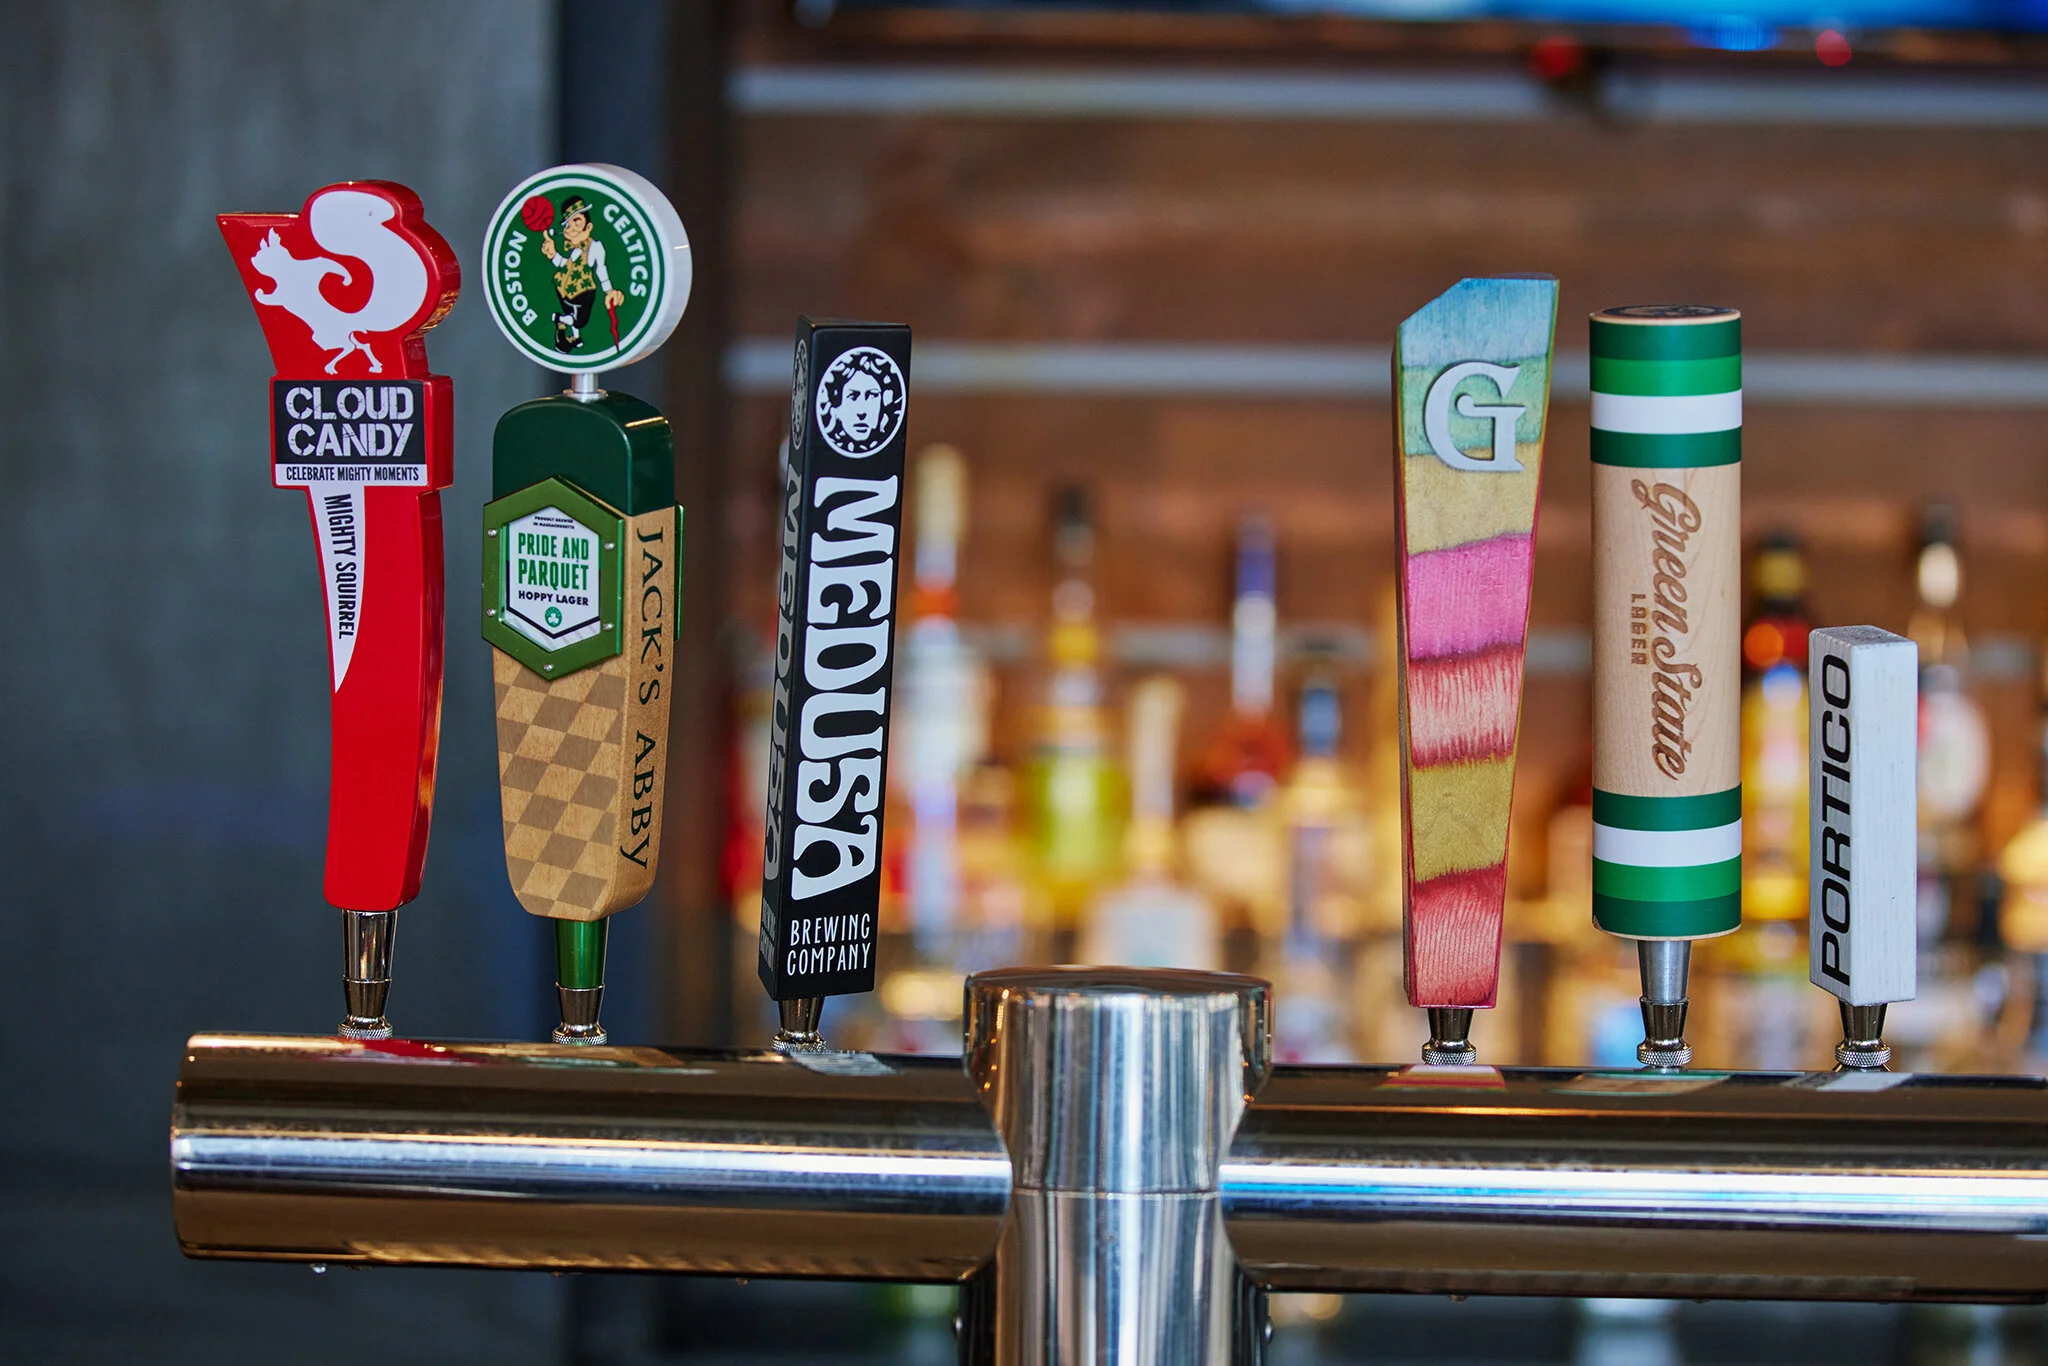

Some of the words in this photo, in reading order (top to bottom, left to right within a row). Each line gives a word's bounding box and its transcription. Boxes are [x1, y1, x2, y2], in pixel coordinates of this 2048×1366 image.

[504, 230, 538, 327] BOSTON
[603, 203, 649, 298] CELTICS
[285, 386, 414, 420] CLOUD
[1423, 360, 1526, 472] G
[286, 466, 335, 481] CELEBRATE
[337, 466, 372, 481] MIGHTY
[374, 466, 419, 481] MOMENTS
[287, 423, 414, 457] CANDY
[324, 493, 357, 557] MIGHTY
[518, 532, 558, 558] PRIDE
[562, 537, 589, 560] AND
[1631, 478, 1702, 635] Green
[335, 561, 357, 640] SQUIRREL
[518, 558, 589, 591] PARQUET
[518, 590, 554, 603] HOPPY
[556, 594, 589, 606] LAGER
[637, 526, 664, 706] JACK'S
[1631, 593, 1647, 665] LAGER
[791, 474, 898, 901] MEDUSA
[1650, 636, 1703, 781] State
[620, 730, 657, 870] ABBY
[1821, 653, 1852, 988] PORTICO
[786, 942, 872, 977] COMPANY
[790, 912, 872, 946] BREWING
